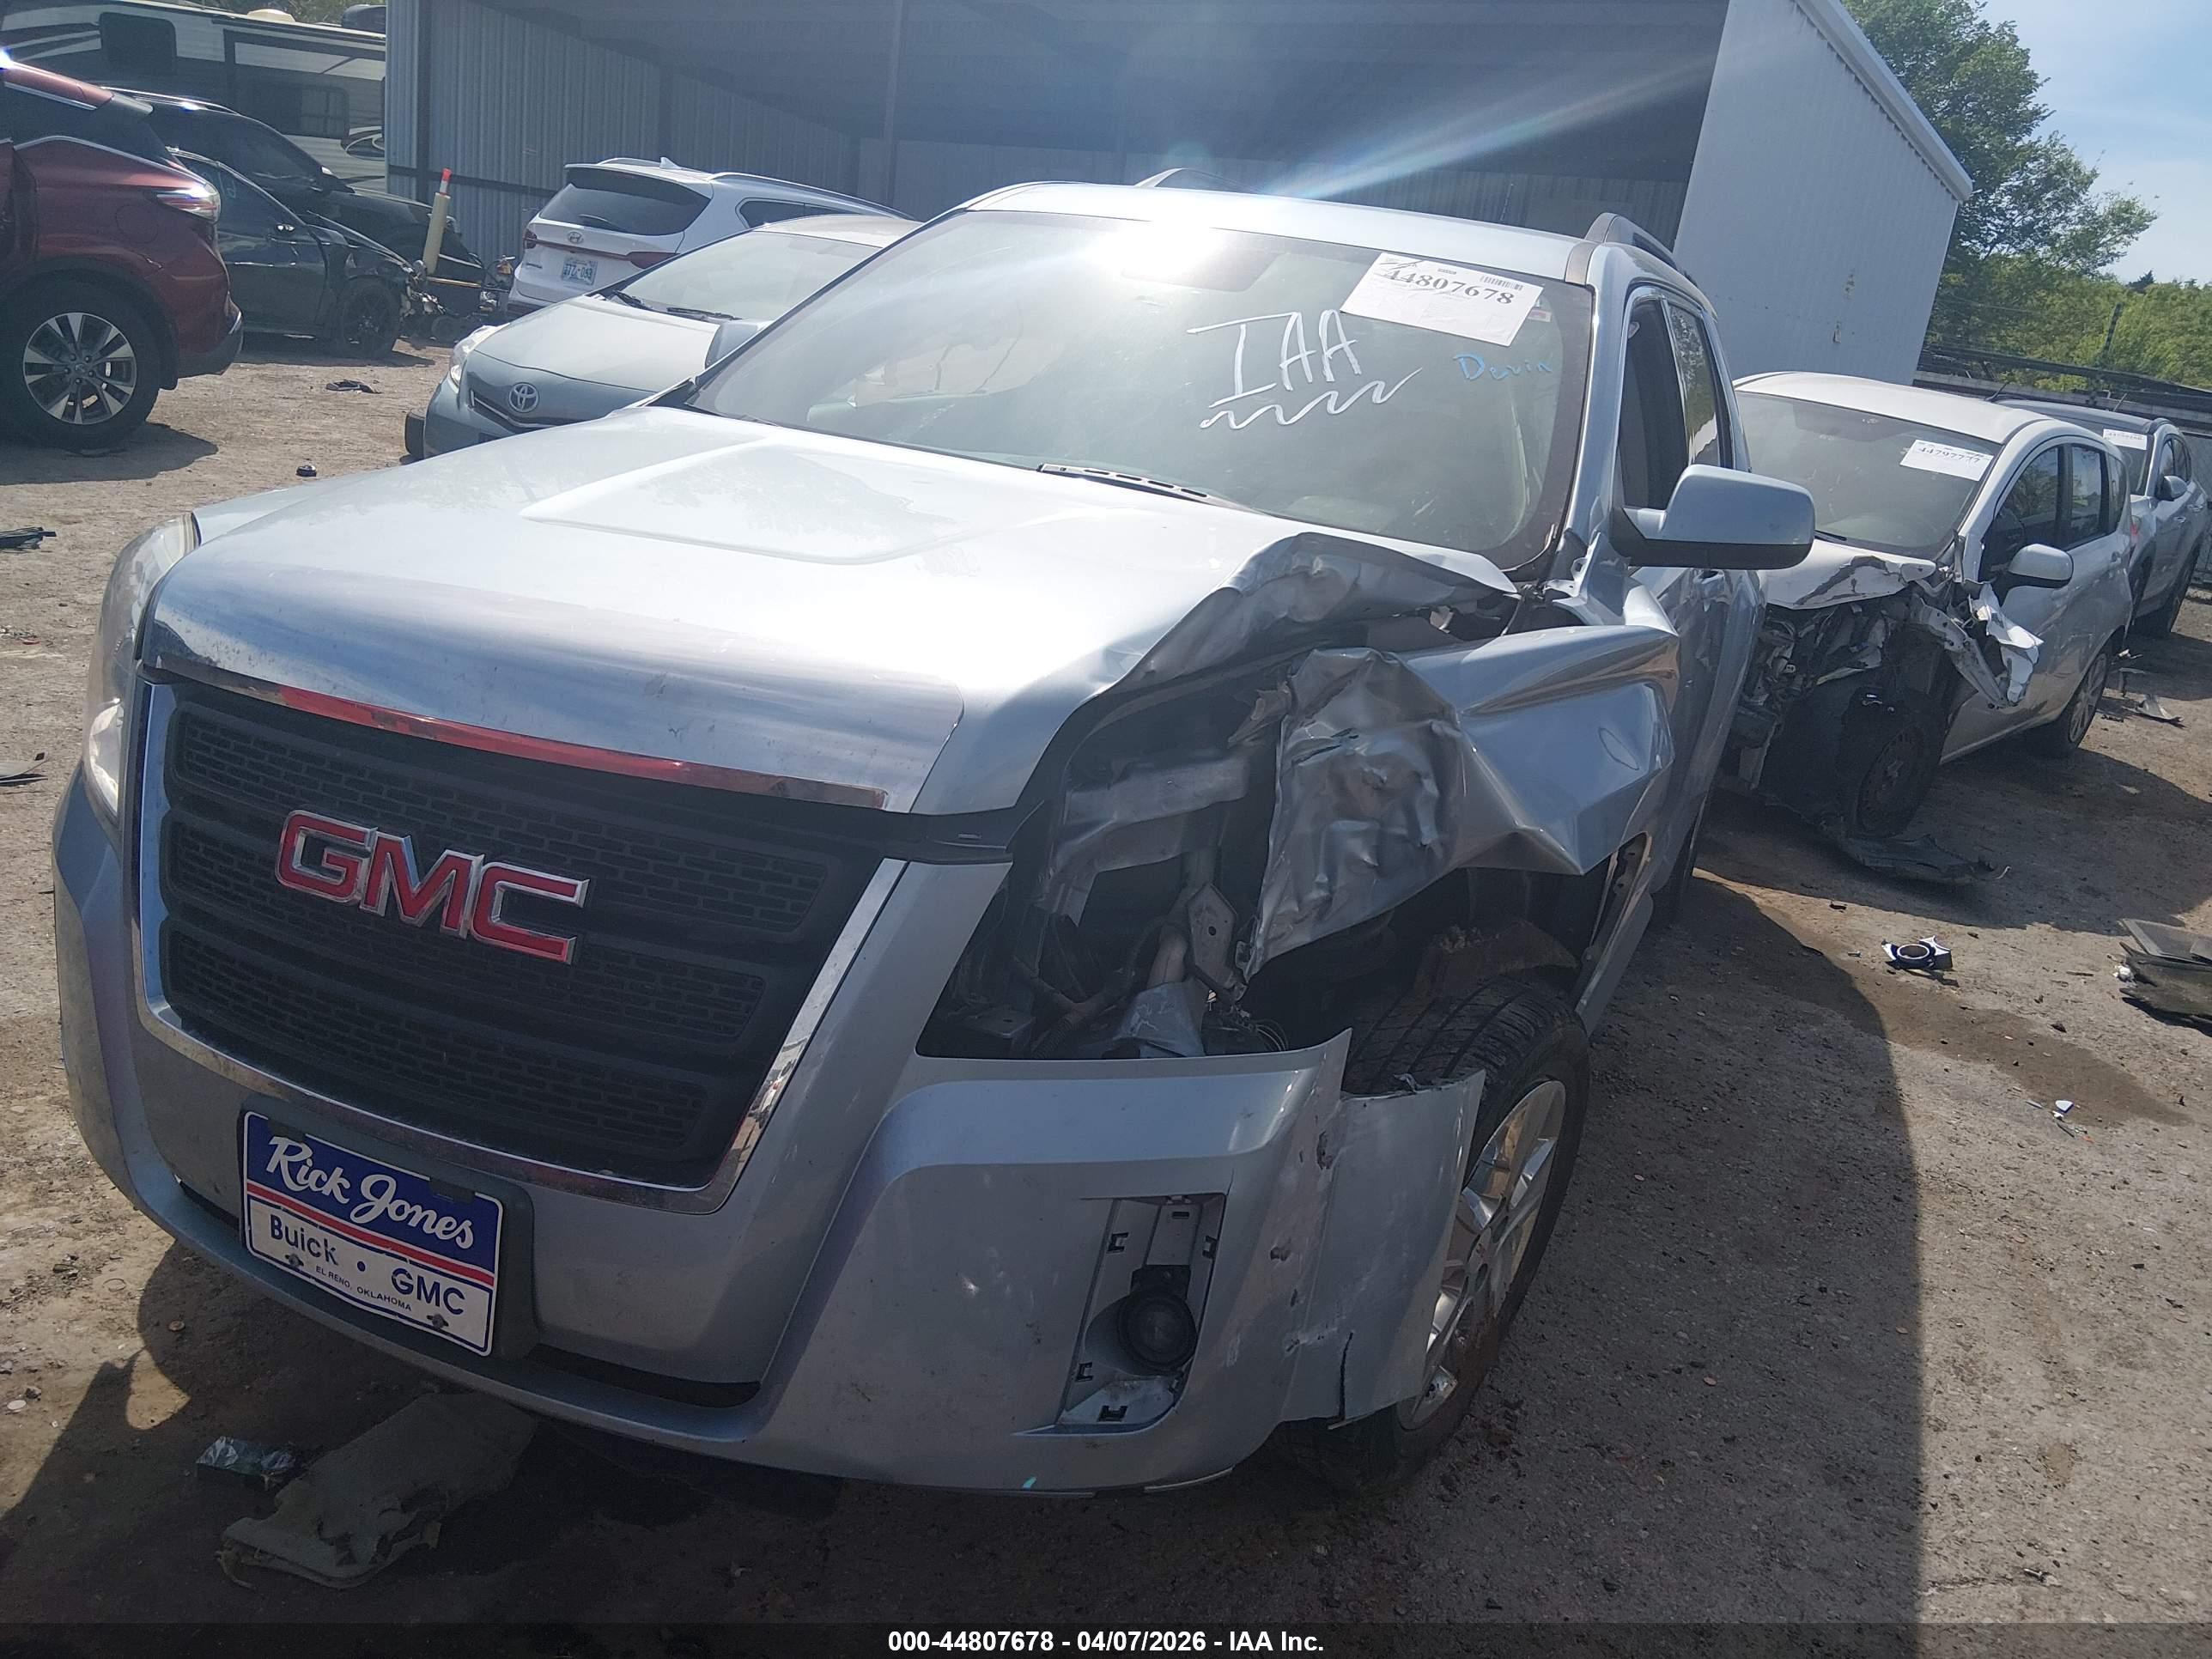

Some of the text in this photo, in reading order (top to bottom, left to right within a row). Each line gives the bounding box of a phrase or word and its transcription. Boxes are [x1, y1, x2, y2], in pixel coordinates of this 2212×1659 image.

[1383, 270, 1516, 304] 44807678
[1186, 309, 1364, 409] IAA
[275, 809, 590, 964] GMC
[265, 1135, 475, 1249] Rick Jones
[269, 1213, 465, 1316] Buick GMC
[314, 1266, 328, 1275] EL
[356, 1286, 412, 1312] OKLAHOMA
